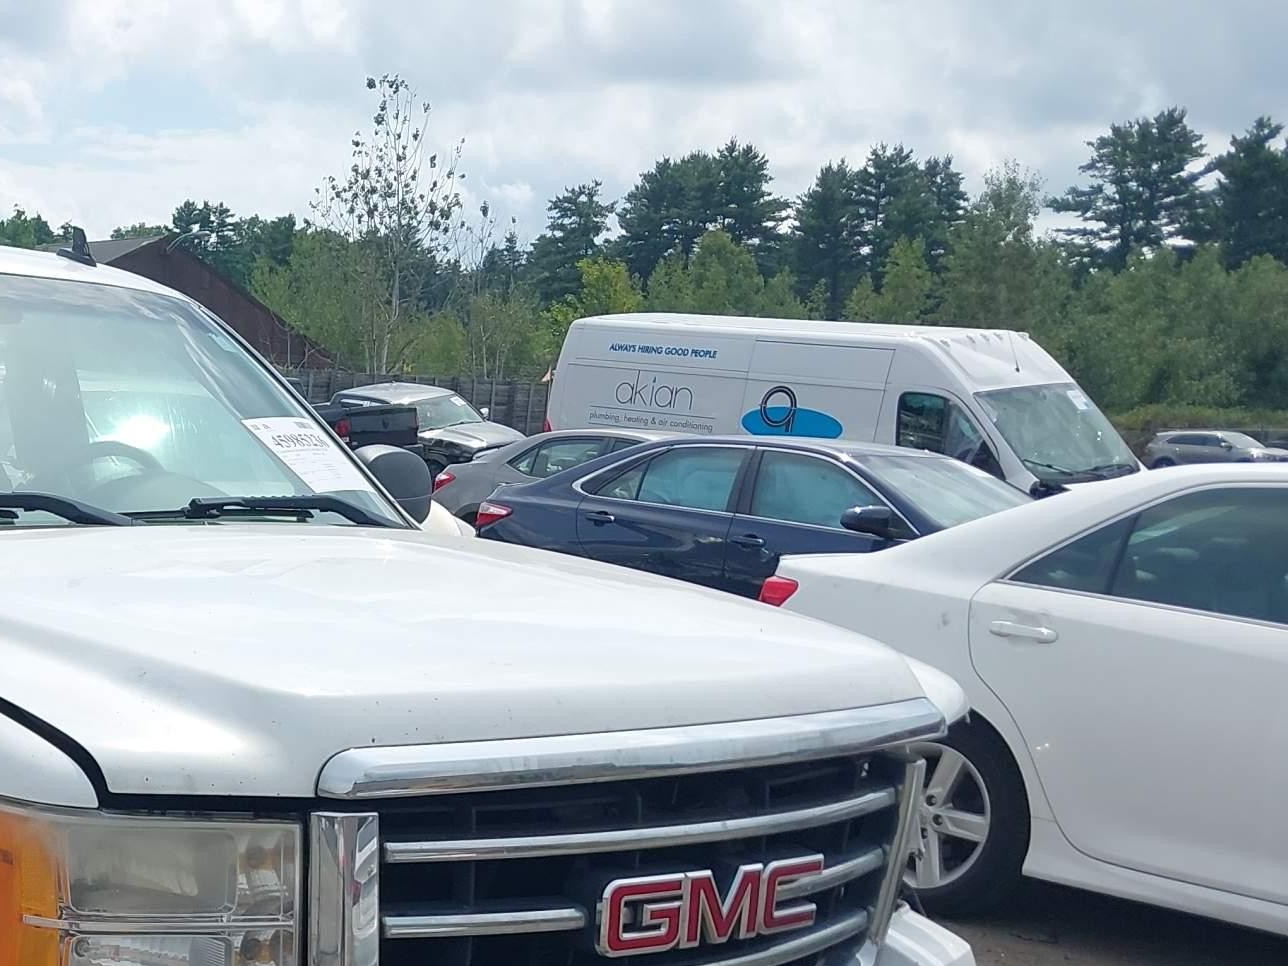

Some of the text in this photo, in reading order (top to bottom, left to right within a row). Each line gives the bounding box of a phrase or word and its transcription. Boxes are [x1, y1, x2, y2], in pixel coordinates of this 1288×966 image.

[609, 343, 718, 359] ALWAYS HIRING GOOD PEOPLE
[615, 369, 694, 410] akian
[624, 412, 649, 427] heating
[651, 416, 657, 425] &
[658, 417, 668, 427] air
[670, 418, 713, 433] conditioning
[595, 853, 824, 958] GMC
